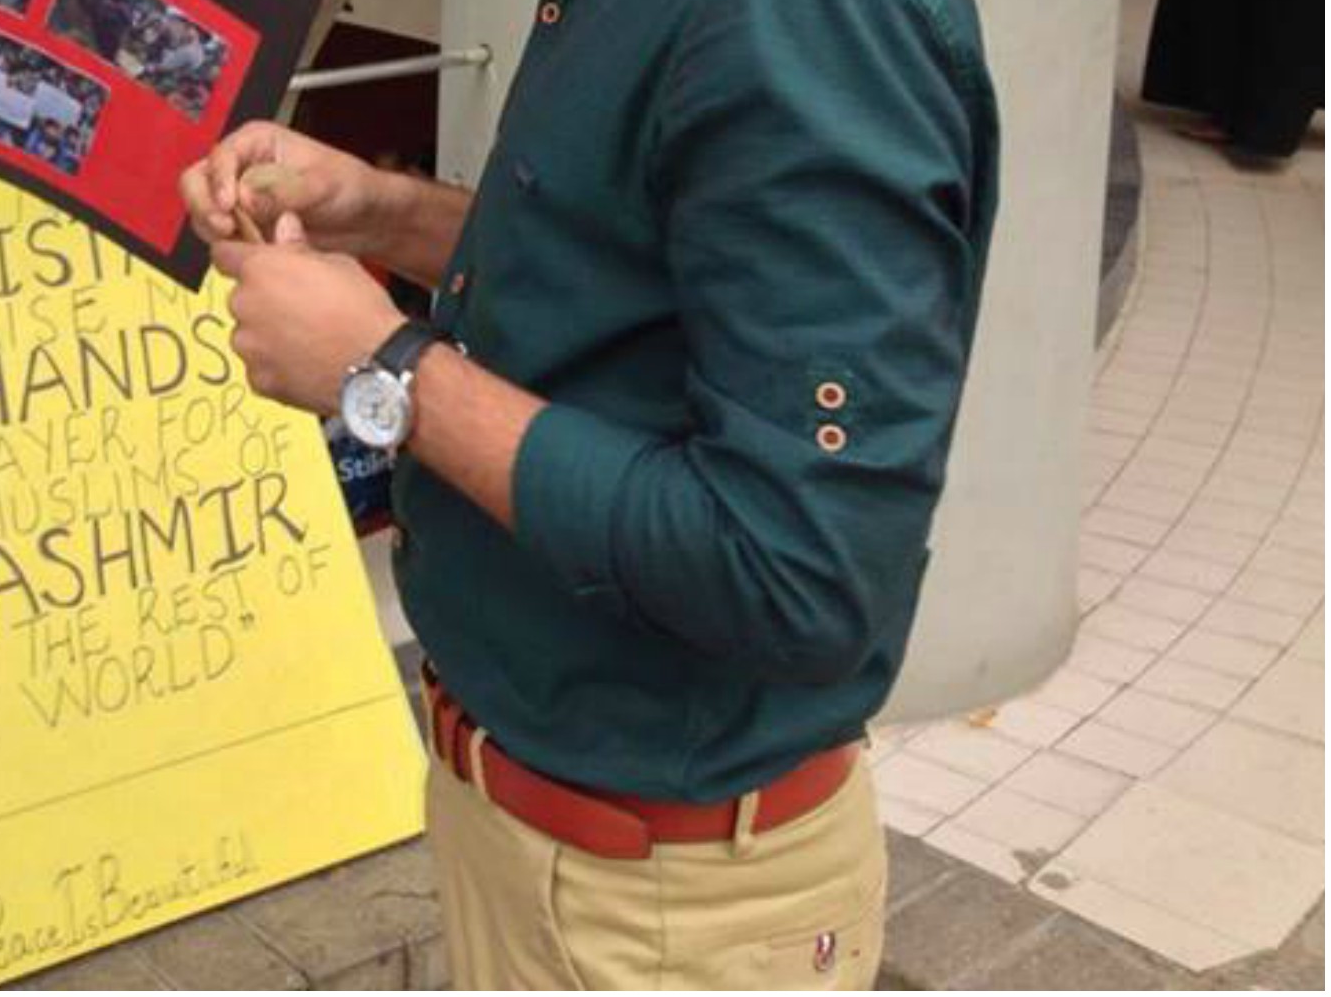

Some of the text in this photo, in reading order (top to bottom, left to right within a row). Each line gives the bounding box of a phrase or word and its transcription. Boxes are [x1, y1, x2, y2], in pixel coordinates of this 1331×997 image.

[157, 384, 260, 450] FOR
[239, 421, 291, 479] OF
[12, 601, 111, 677] THE
[138, 564, 250, 639] REST
[275, 544, 332, 596] OF
